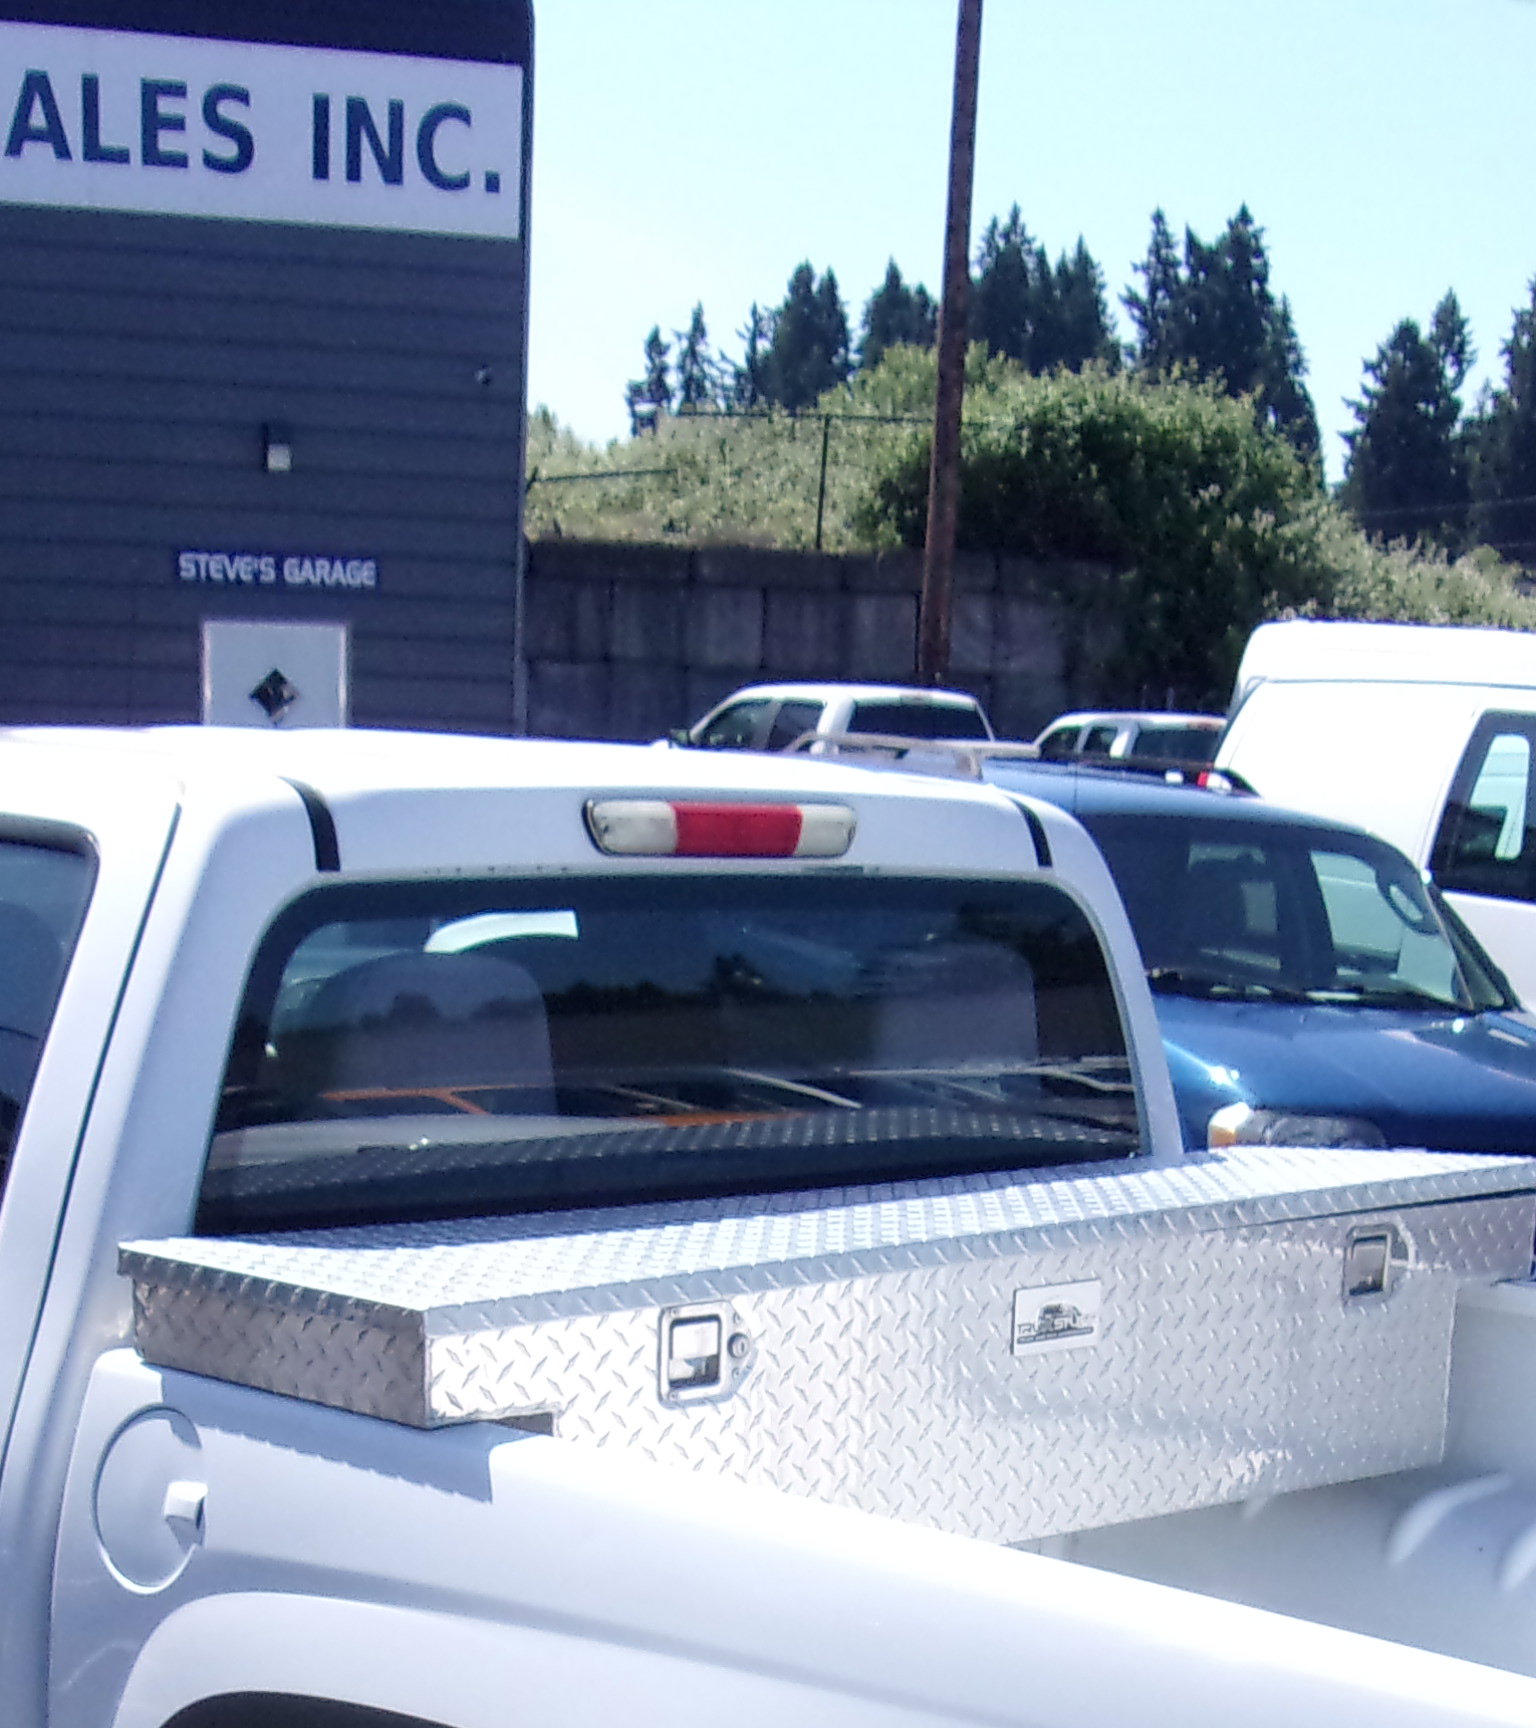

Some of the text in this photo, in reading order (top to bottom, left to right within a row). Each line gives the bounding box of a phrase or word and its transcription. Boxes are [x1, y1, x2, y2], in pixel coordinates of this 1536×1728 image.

[312, 92, 501, 193] INC.
[178, 552, 377, 588] STEVE'S GARAGE
